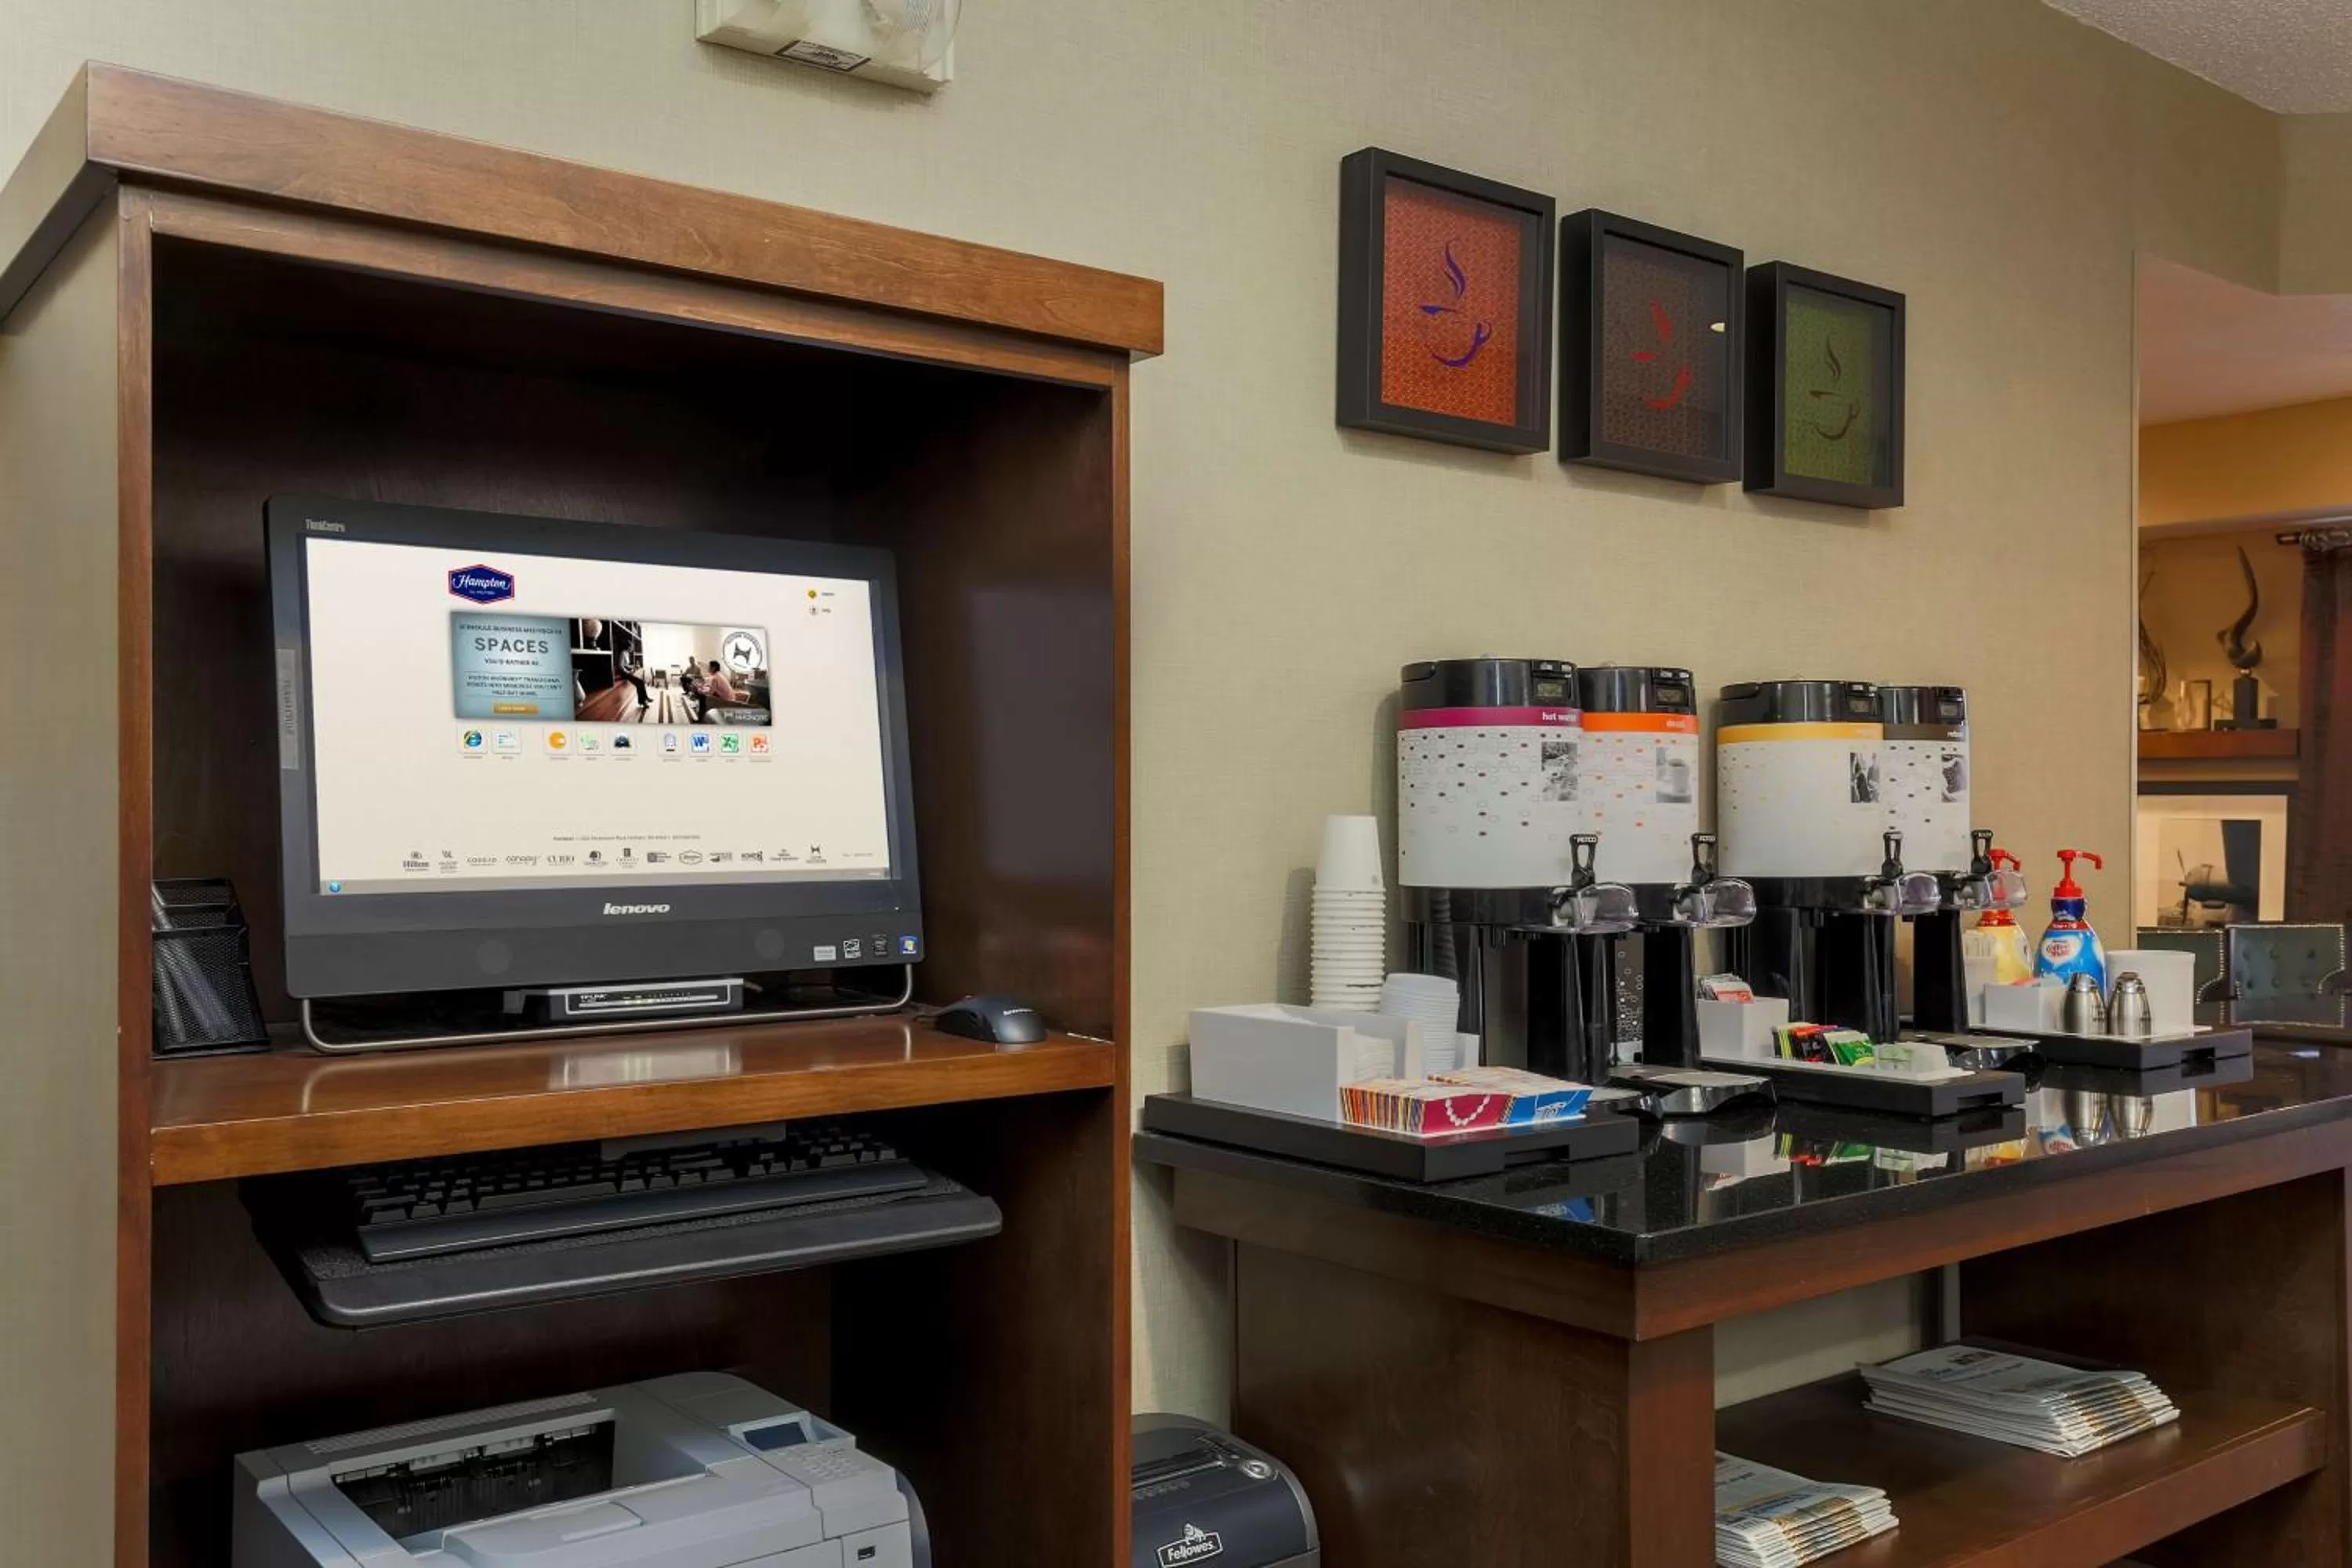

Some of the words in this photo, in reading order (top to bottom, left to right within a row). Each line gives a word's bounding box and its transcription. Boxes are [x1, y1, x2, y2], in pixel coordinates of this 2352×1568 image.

[452, 574, 510, 590] Hampton
[474, 637, 549, 654] SPACES
[1542, 711, 1556, 720] hot
[603, 902, 670, 915] lenovo
[1167, 1541, 1214, 1561] Fellowes
